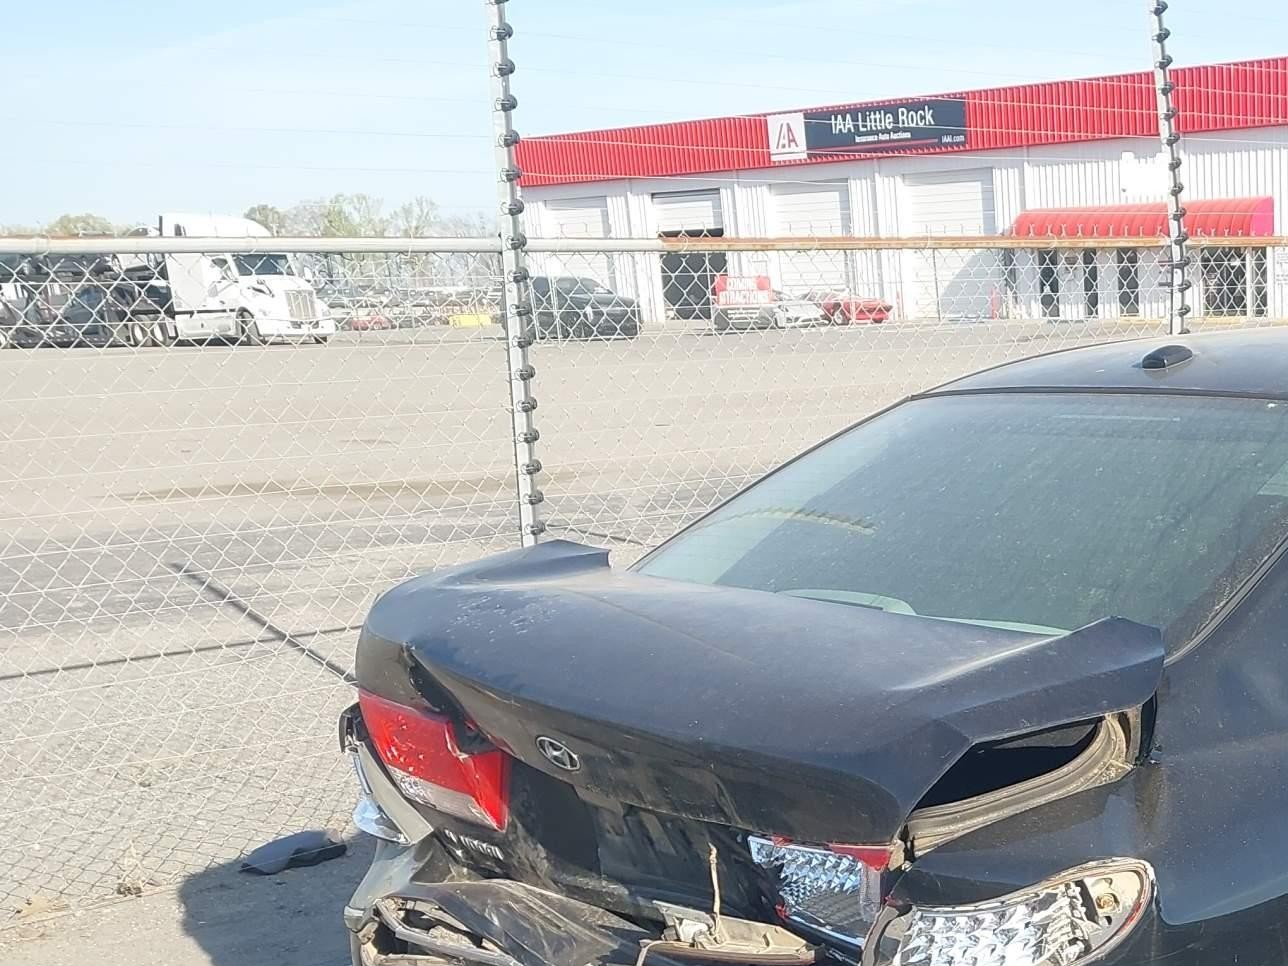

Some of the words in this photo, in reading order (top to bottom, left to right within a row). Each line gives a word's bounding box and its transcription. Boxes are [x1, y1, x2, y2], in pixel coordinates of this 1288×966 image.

[831, 114, 854, 134] IAA
[858, 110, 894, 132] Little
[898, 105, 935, 127] Rock
